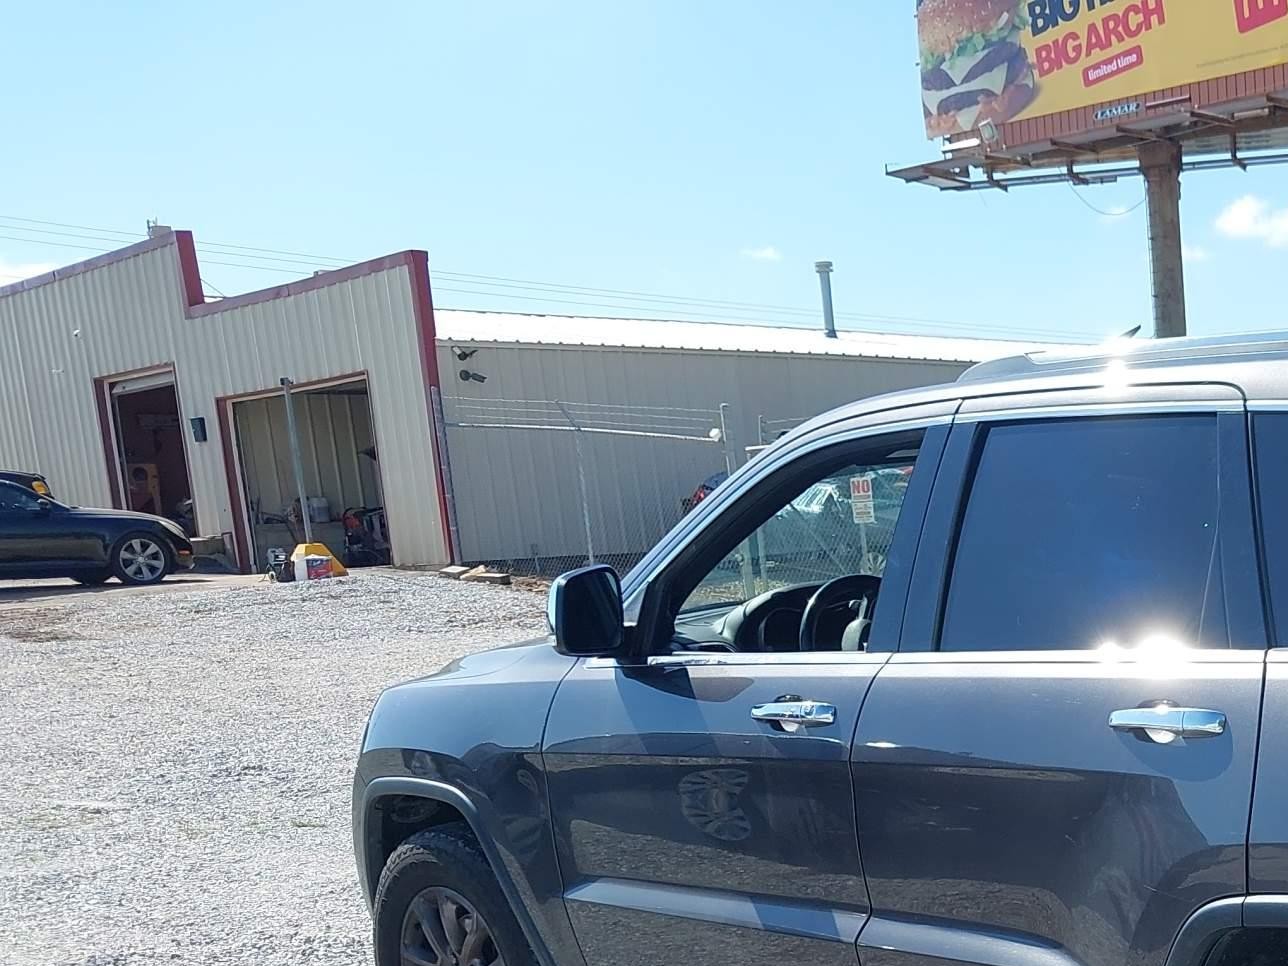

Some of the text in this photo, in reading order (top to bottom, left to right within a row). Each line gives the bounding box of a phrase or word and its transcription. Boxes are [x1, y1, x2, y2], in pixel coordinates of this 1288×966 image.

[1028, 0, 1081, 37] BIG
[1035, 31, 1082, 78] BIG
[1085, 0, 1166, 57] ARCH
[1088, 53, 1137, 81] limited time
[1096, 102, 1139, 119] LAMAR
[852, 479, 870, 494] NO
